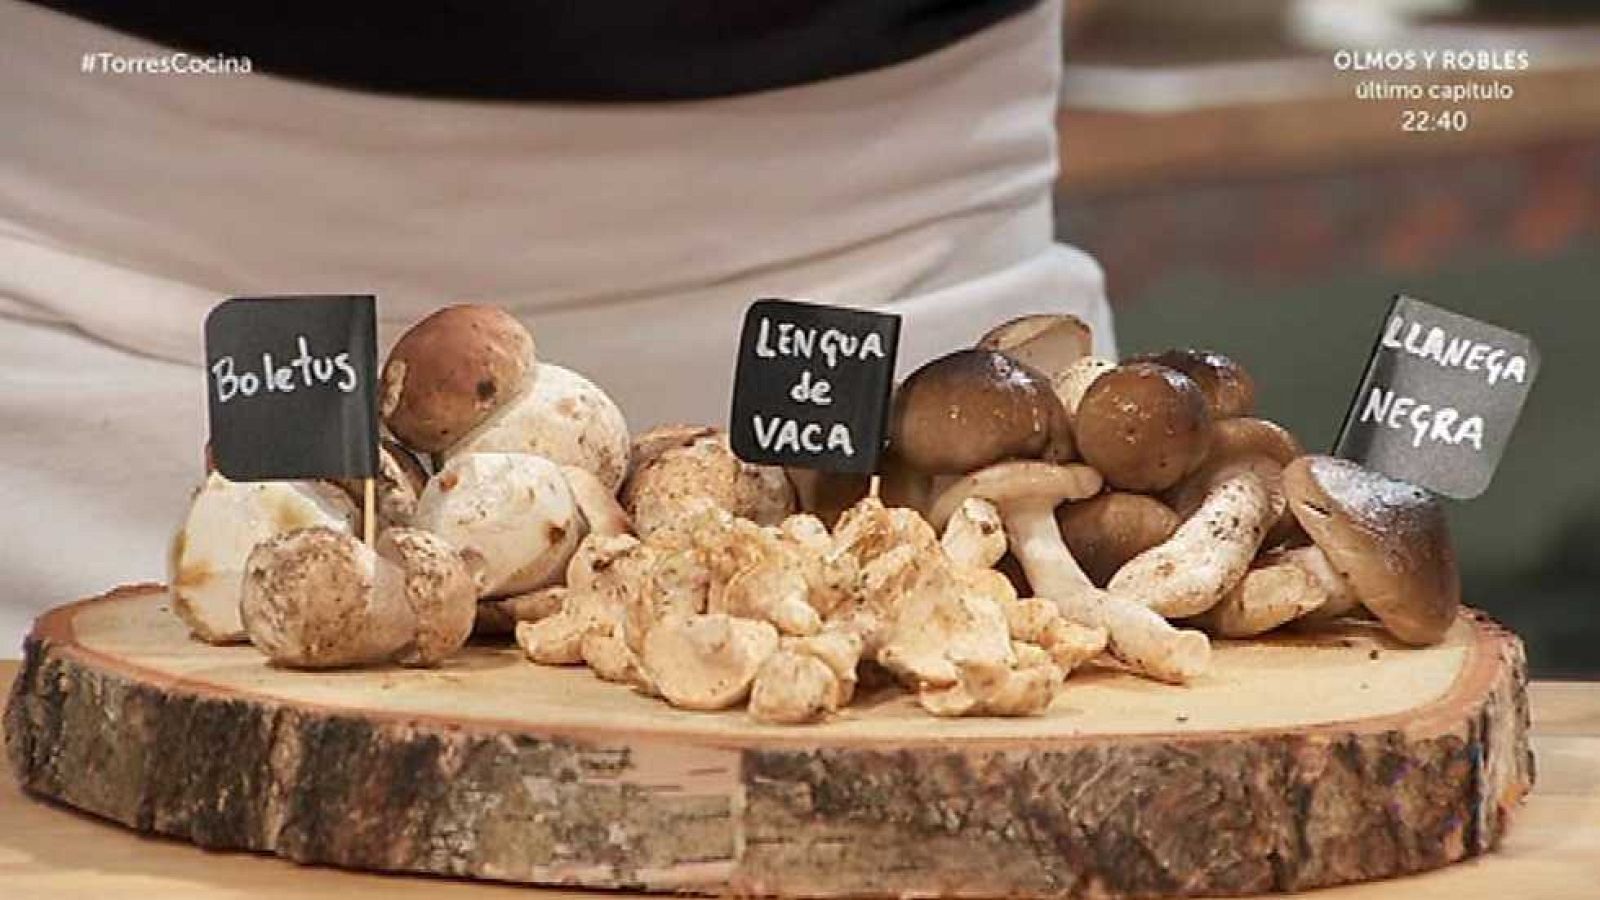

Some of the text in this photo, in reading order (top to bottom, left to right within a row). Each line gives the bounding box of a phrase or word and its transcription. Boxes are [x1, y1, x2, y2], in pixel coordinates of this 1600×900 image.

[212, 335, 358, 403] Boletus
[756, 316, 886, 369] LENGUA
[1381, 316, 1527, 385] LLANEGA
[790, 370, 833, 406] de
[752, 414, 855, 457] VACA
[1360, 387, 1484, 450] NEGRA
